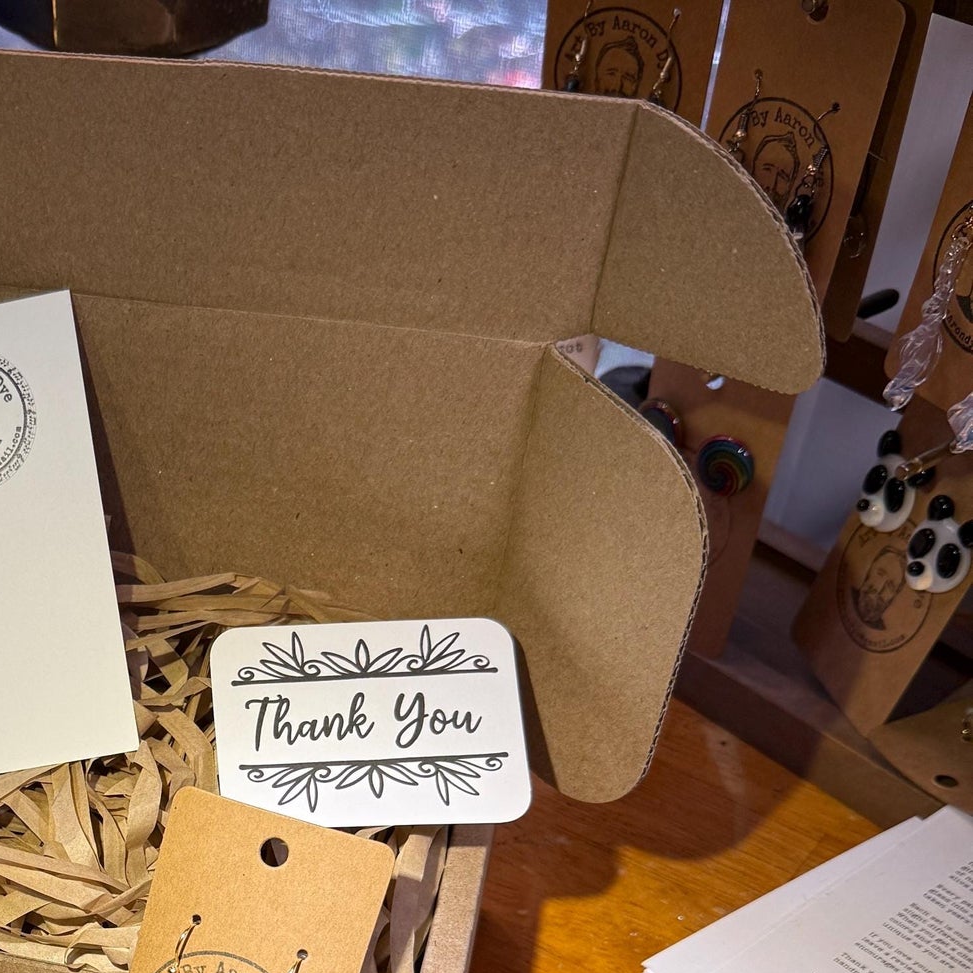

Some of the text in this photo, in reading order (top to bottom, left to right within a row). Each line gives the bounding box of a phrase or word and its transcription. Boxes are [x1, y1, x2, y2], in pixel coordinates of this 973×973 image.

[586, 19, 606, 37] By
[612, 15, 657, 49] Aaron
[774, 107, 815, 149] Aaron
[244, 691, 482, 752] Thank You
